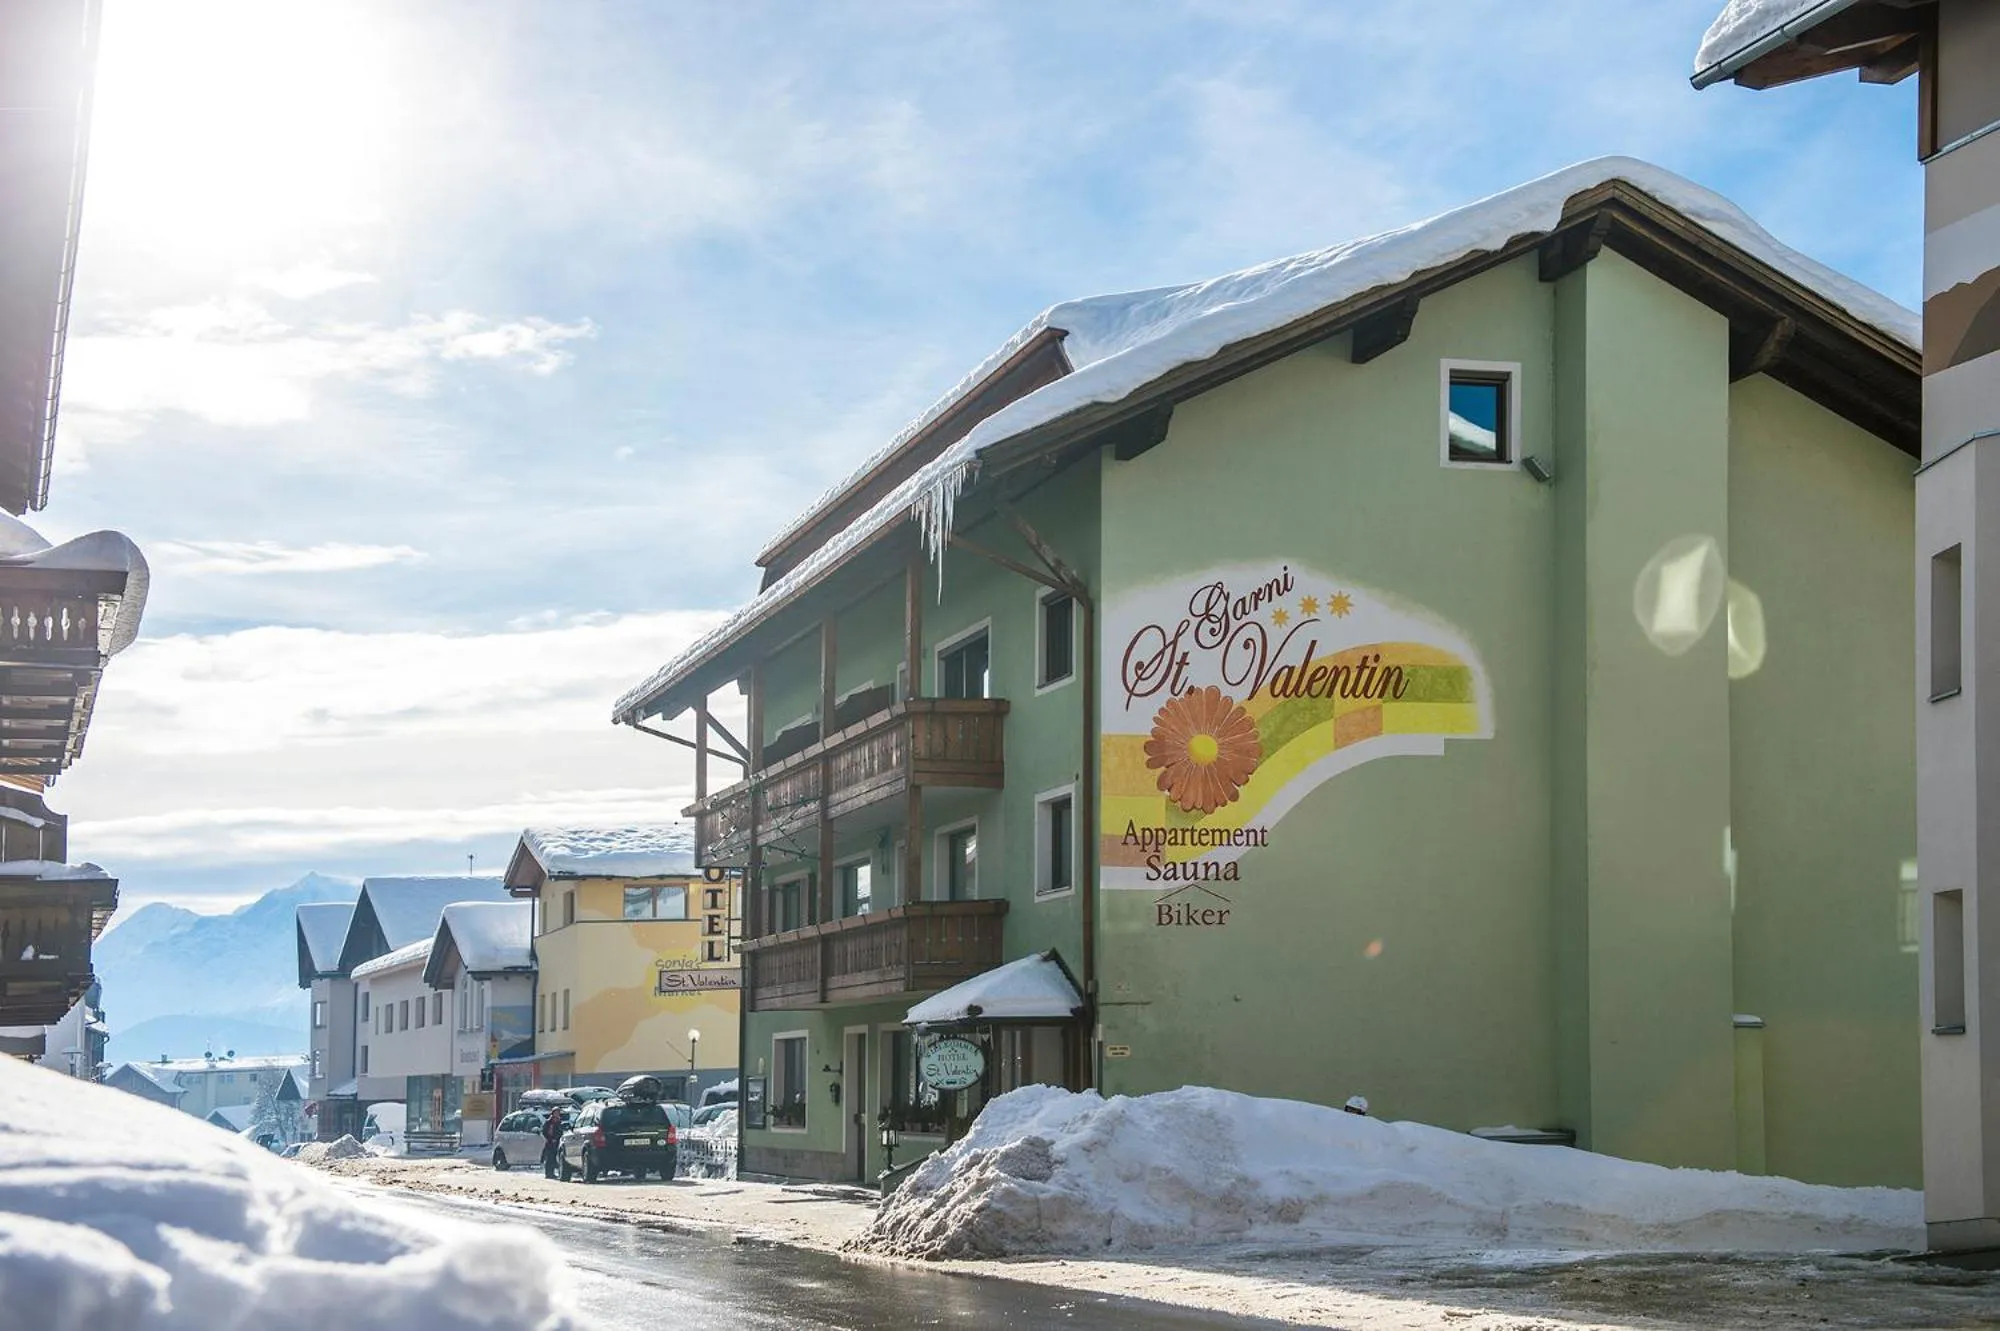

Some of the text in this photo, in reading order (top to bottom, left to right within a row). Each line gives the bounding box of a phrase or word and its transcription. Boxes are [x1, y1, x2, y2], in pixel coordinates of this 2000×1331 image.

[1188, 565, 1295, 650] Garni
[1121, 618, 1411, 712] St. Valentin
[1121, 819, 1270, 852] Appartement
[1145, 854, 1241, 882] Sauna
[1156, 902, 1231, 927] Biker
